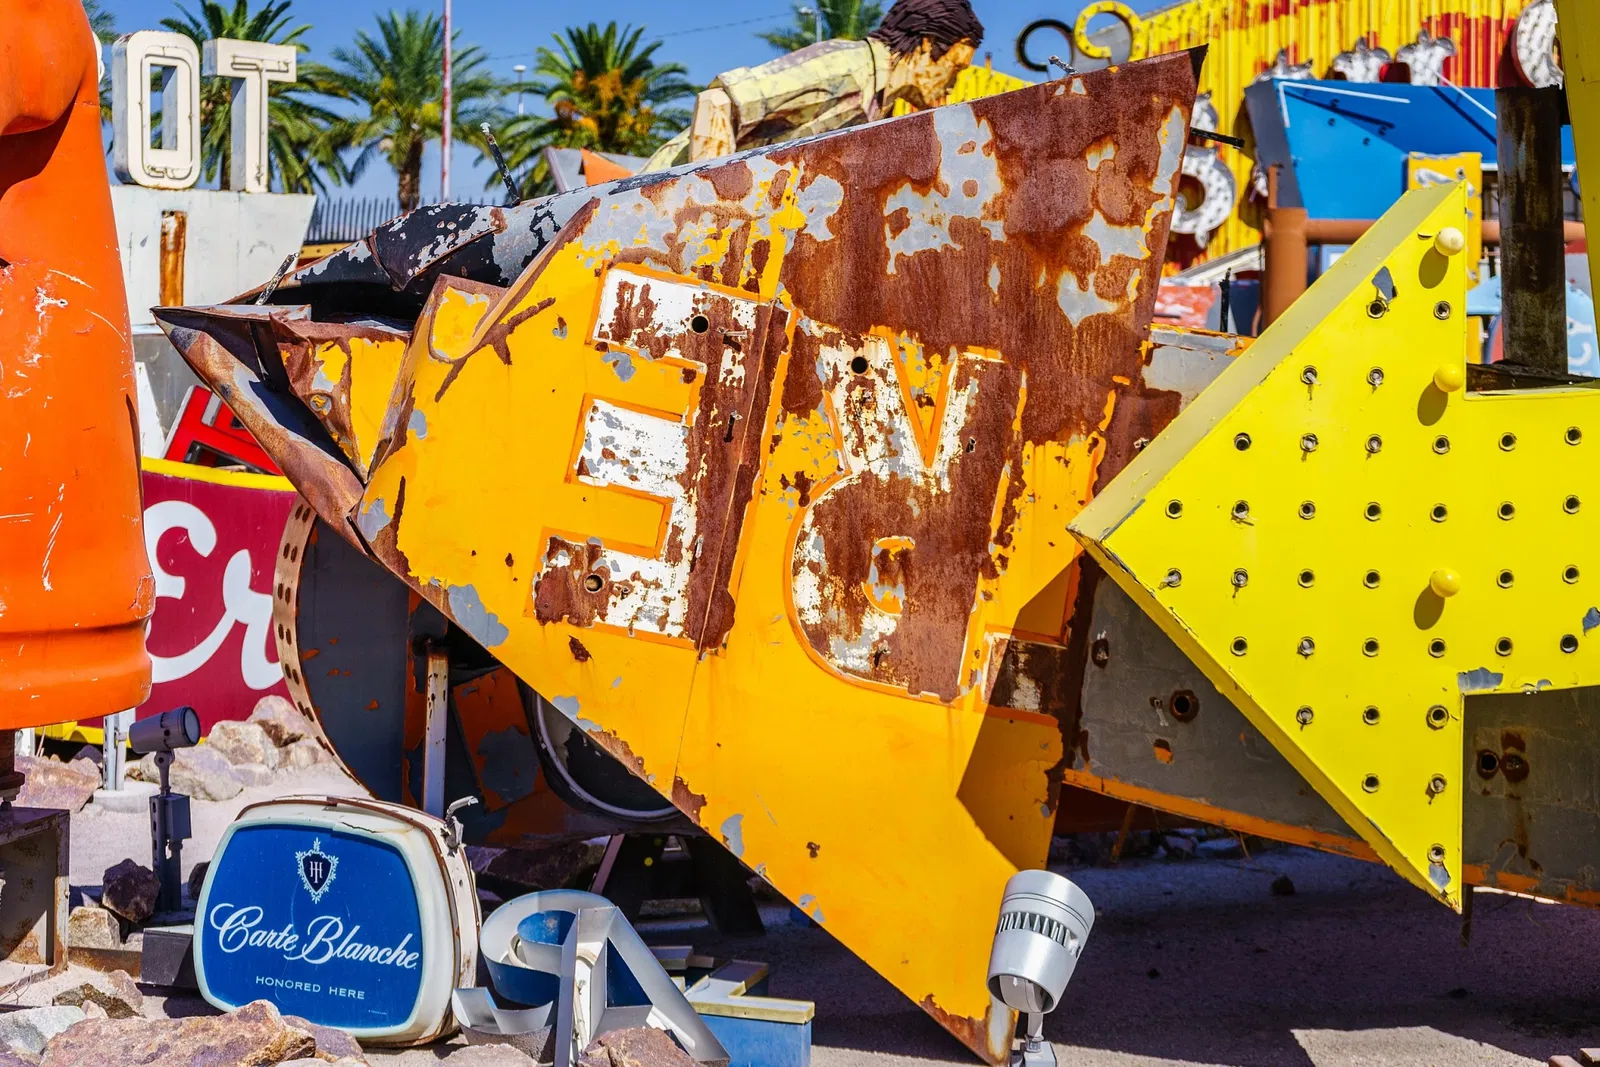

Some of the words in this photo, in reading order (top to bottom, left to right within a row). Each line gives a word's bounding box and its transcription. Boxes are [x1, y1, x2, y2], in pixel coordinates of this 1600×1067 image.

[93, 30, 297, 192] OT
[210, 902, 299, 954] Carte
[283, 915, 420, 970] Blanche
[255, 975, 321, 994] HONORED
[328, 985, 366, 1001] HERE
